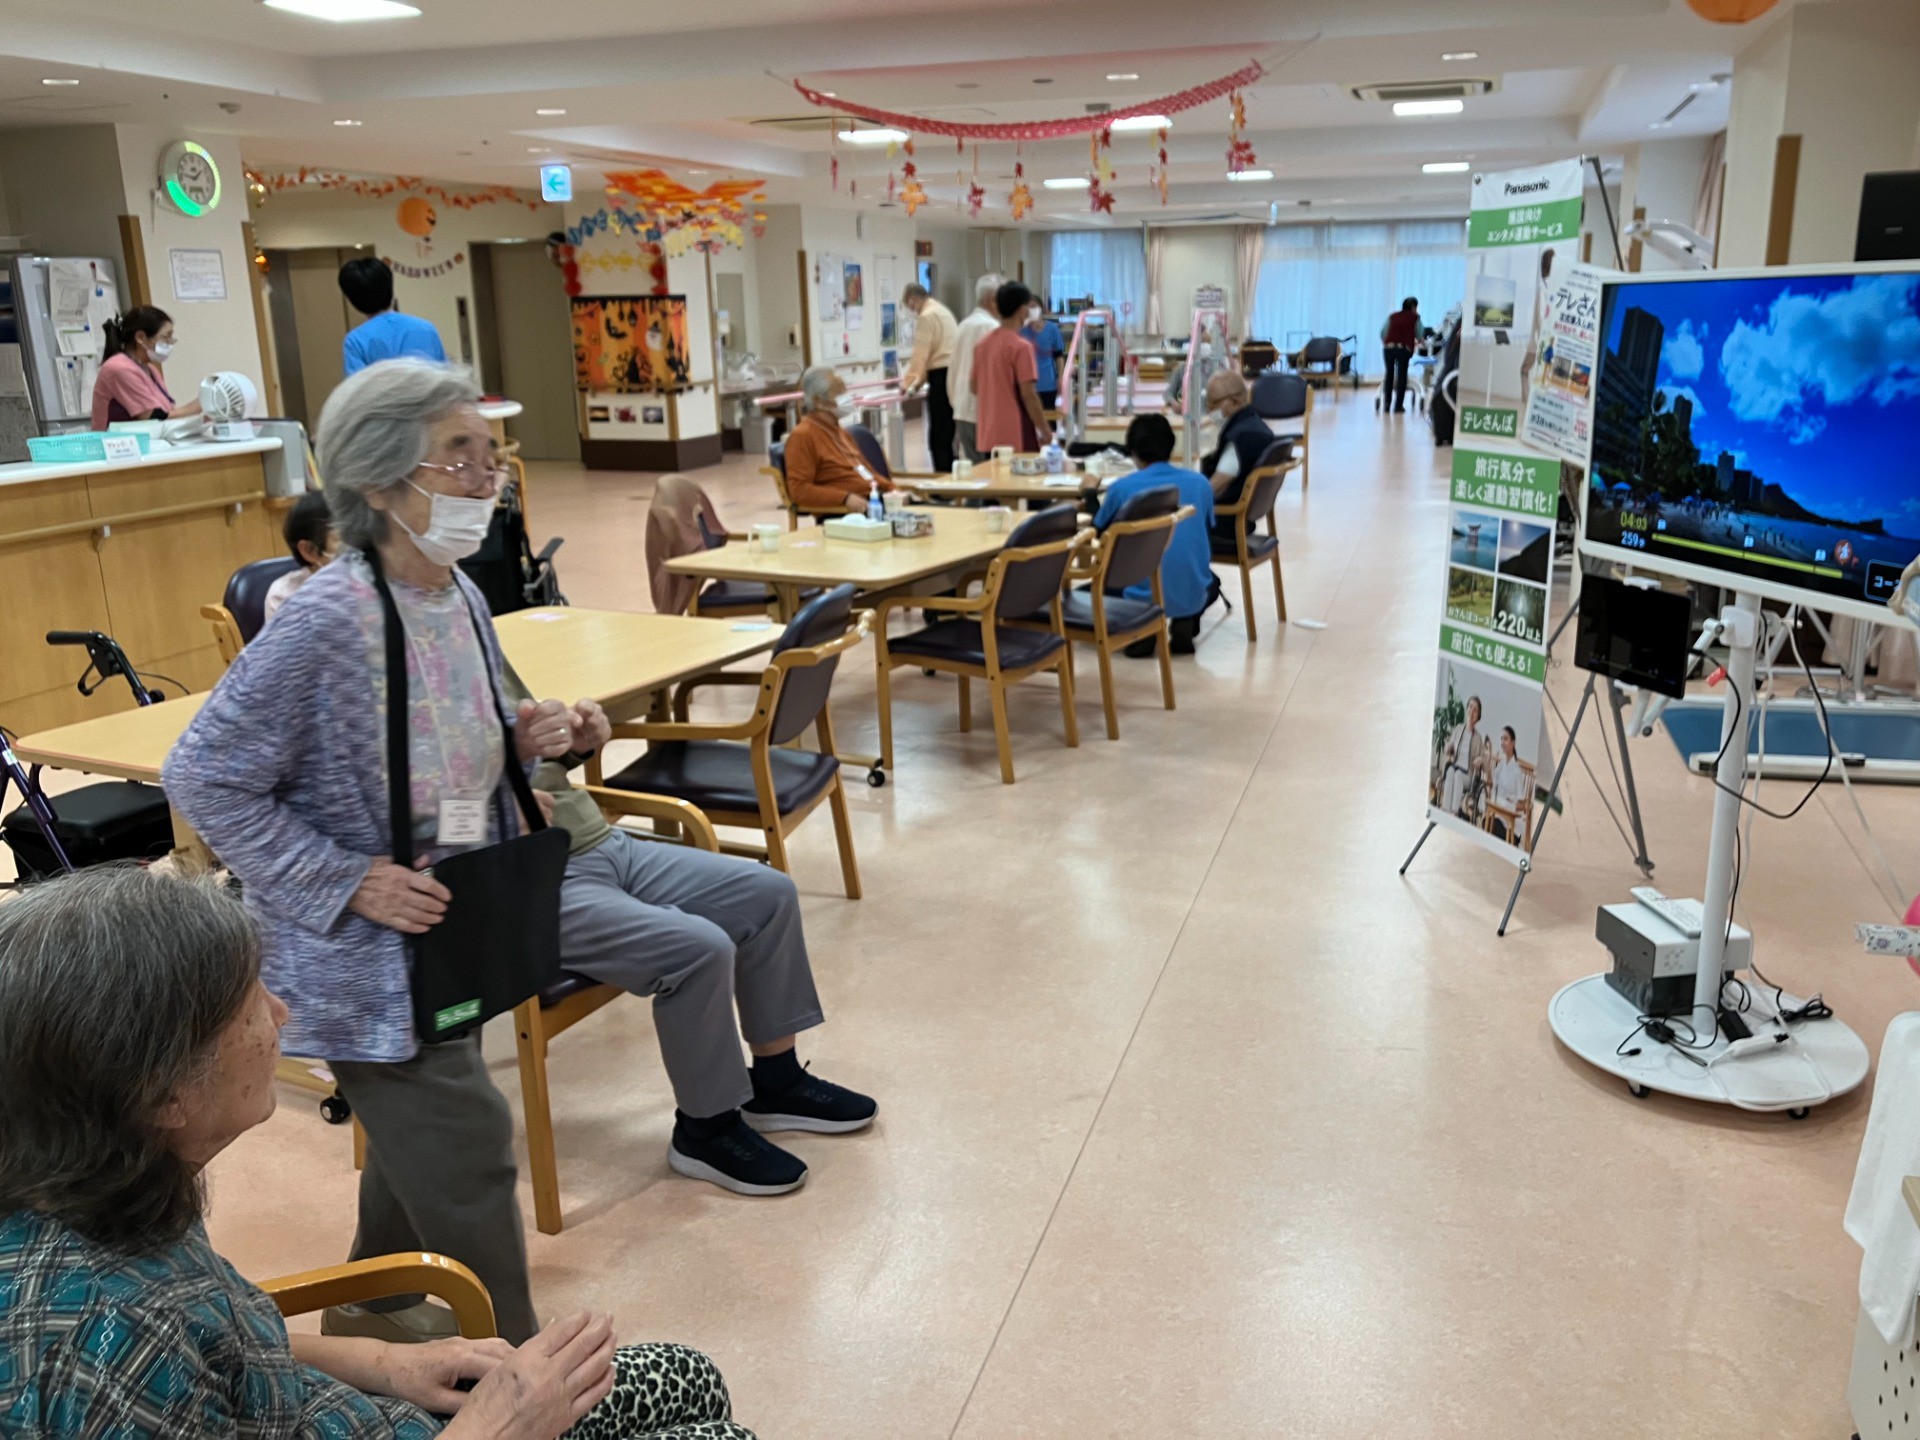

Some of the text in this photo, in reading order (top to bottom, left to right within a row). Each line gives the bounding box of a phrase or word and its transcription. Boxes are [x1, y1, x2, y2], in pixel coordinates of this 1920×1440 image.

[1504, 177, 1550, 195] Panasonic
[1463, 411, 1514, 433] テレさんぽ
[1475, 456, 1536, 484] 旅行気分で
